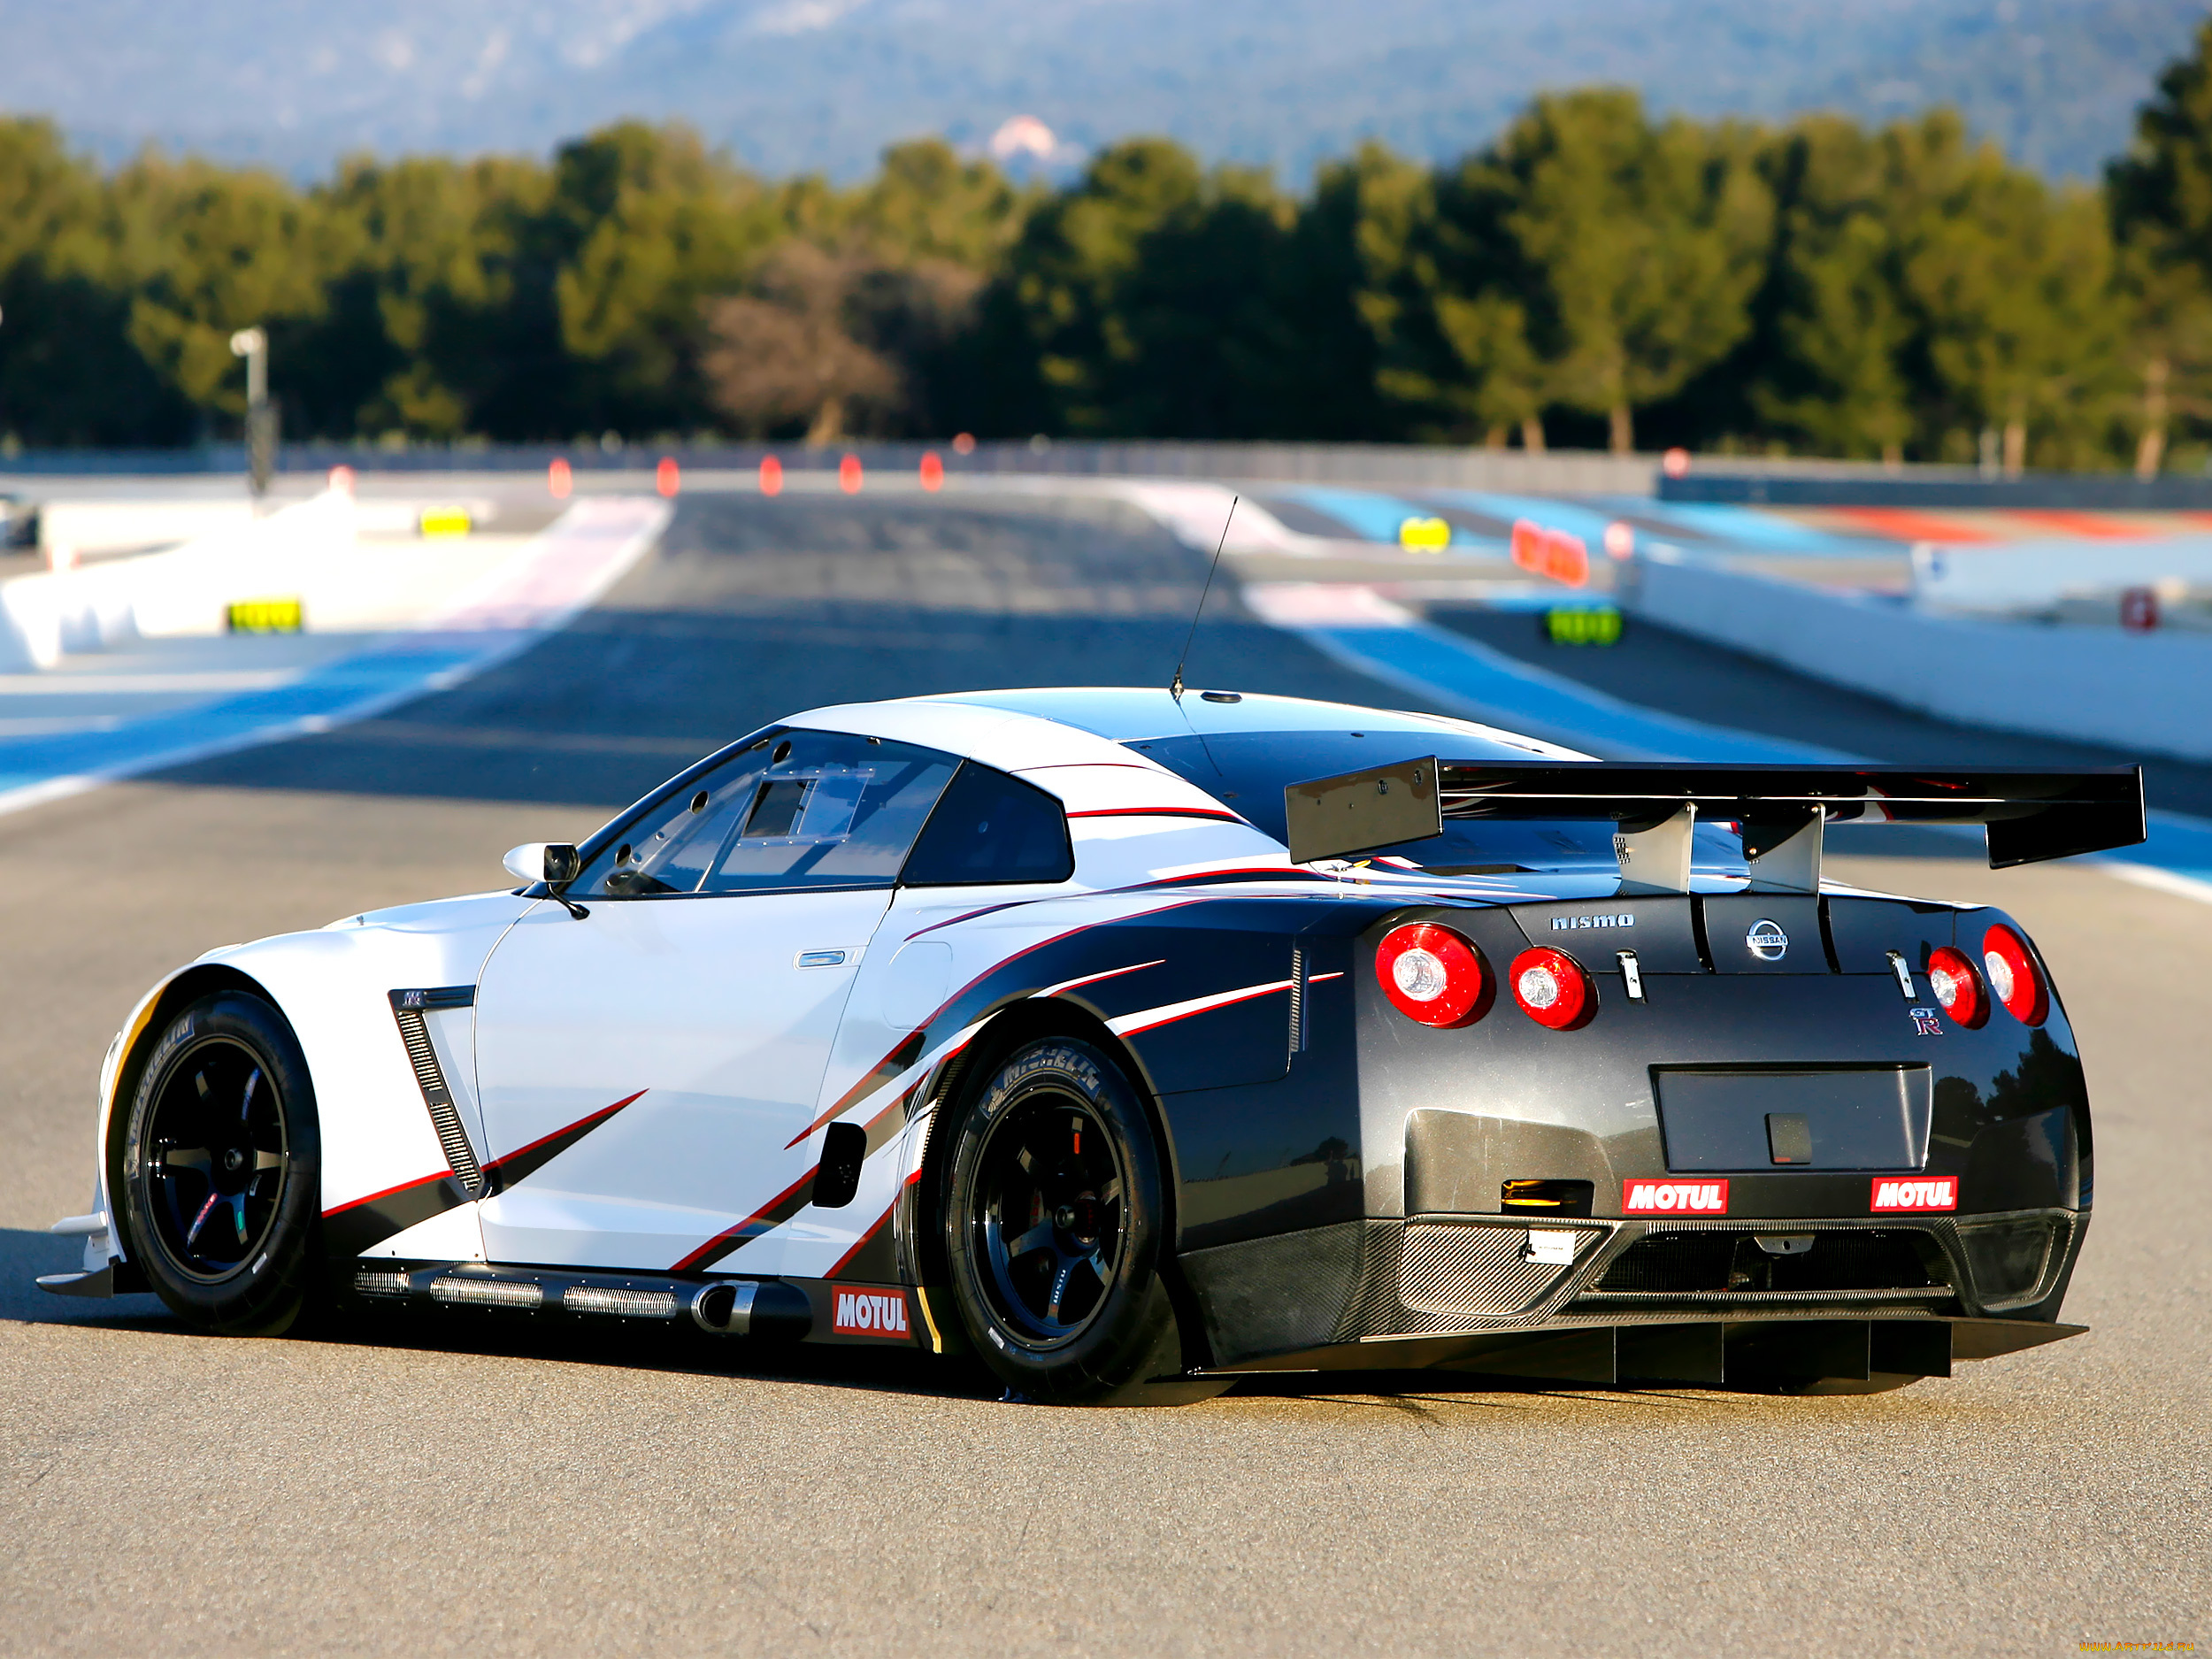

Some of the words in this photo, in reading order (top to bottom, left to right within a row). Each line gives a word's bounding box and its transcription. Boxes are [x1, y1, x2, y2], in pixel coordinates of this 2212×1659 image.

[1627, 1185, 1723, 1210] MOTUL
[1875, 1181, 1954, 1208] MOTUL
[836, 1294, 906, 1332] MOTUL
